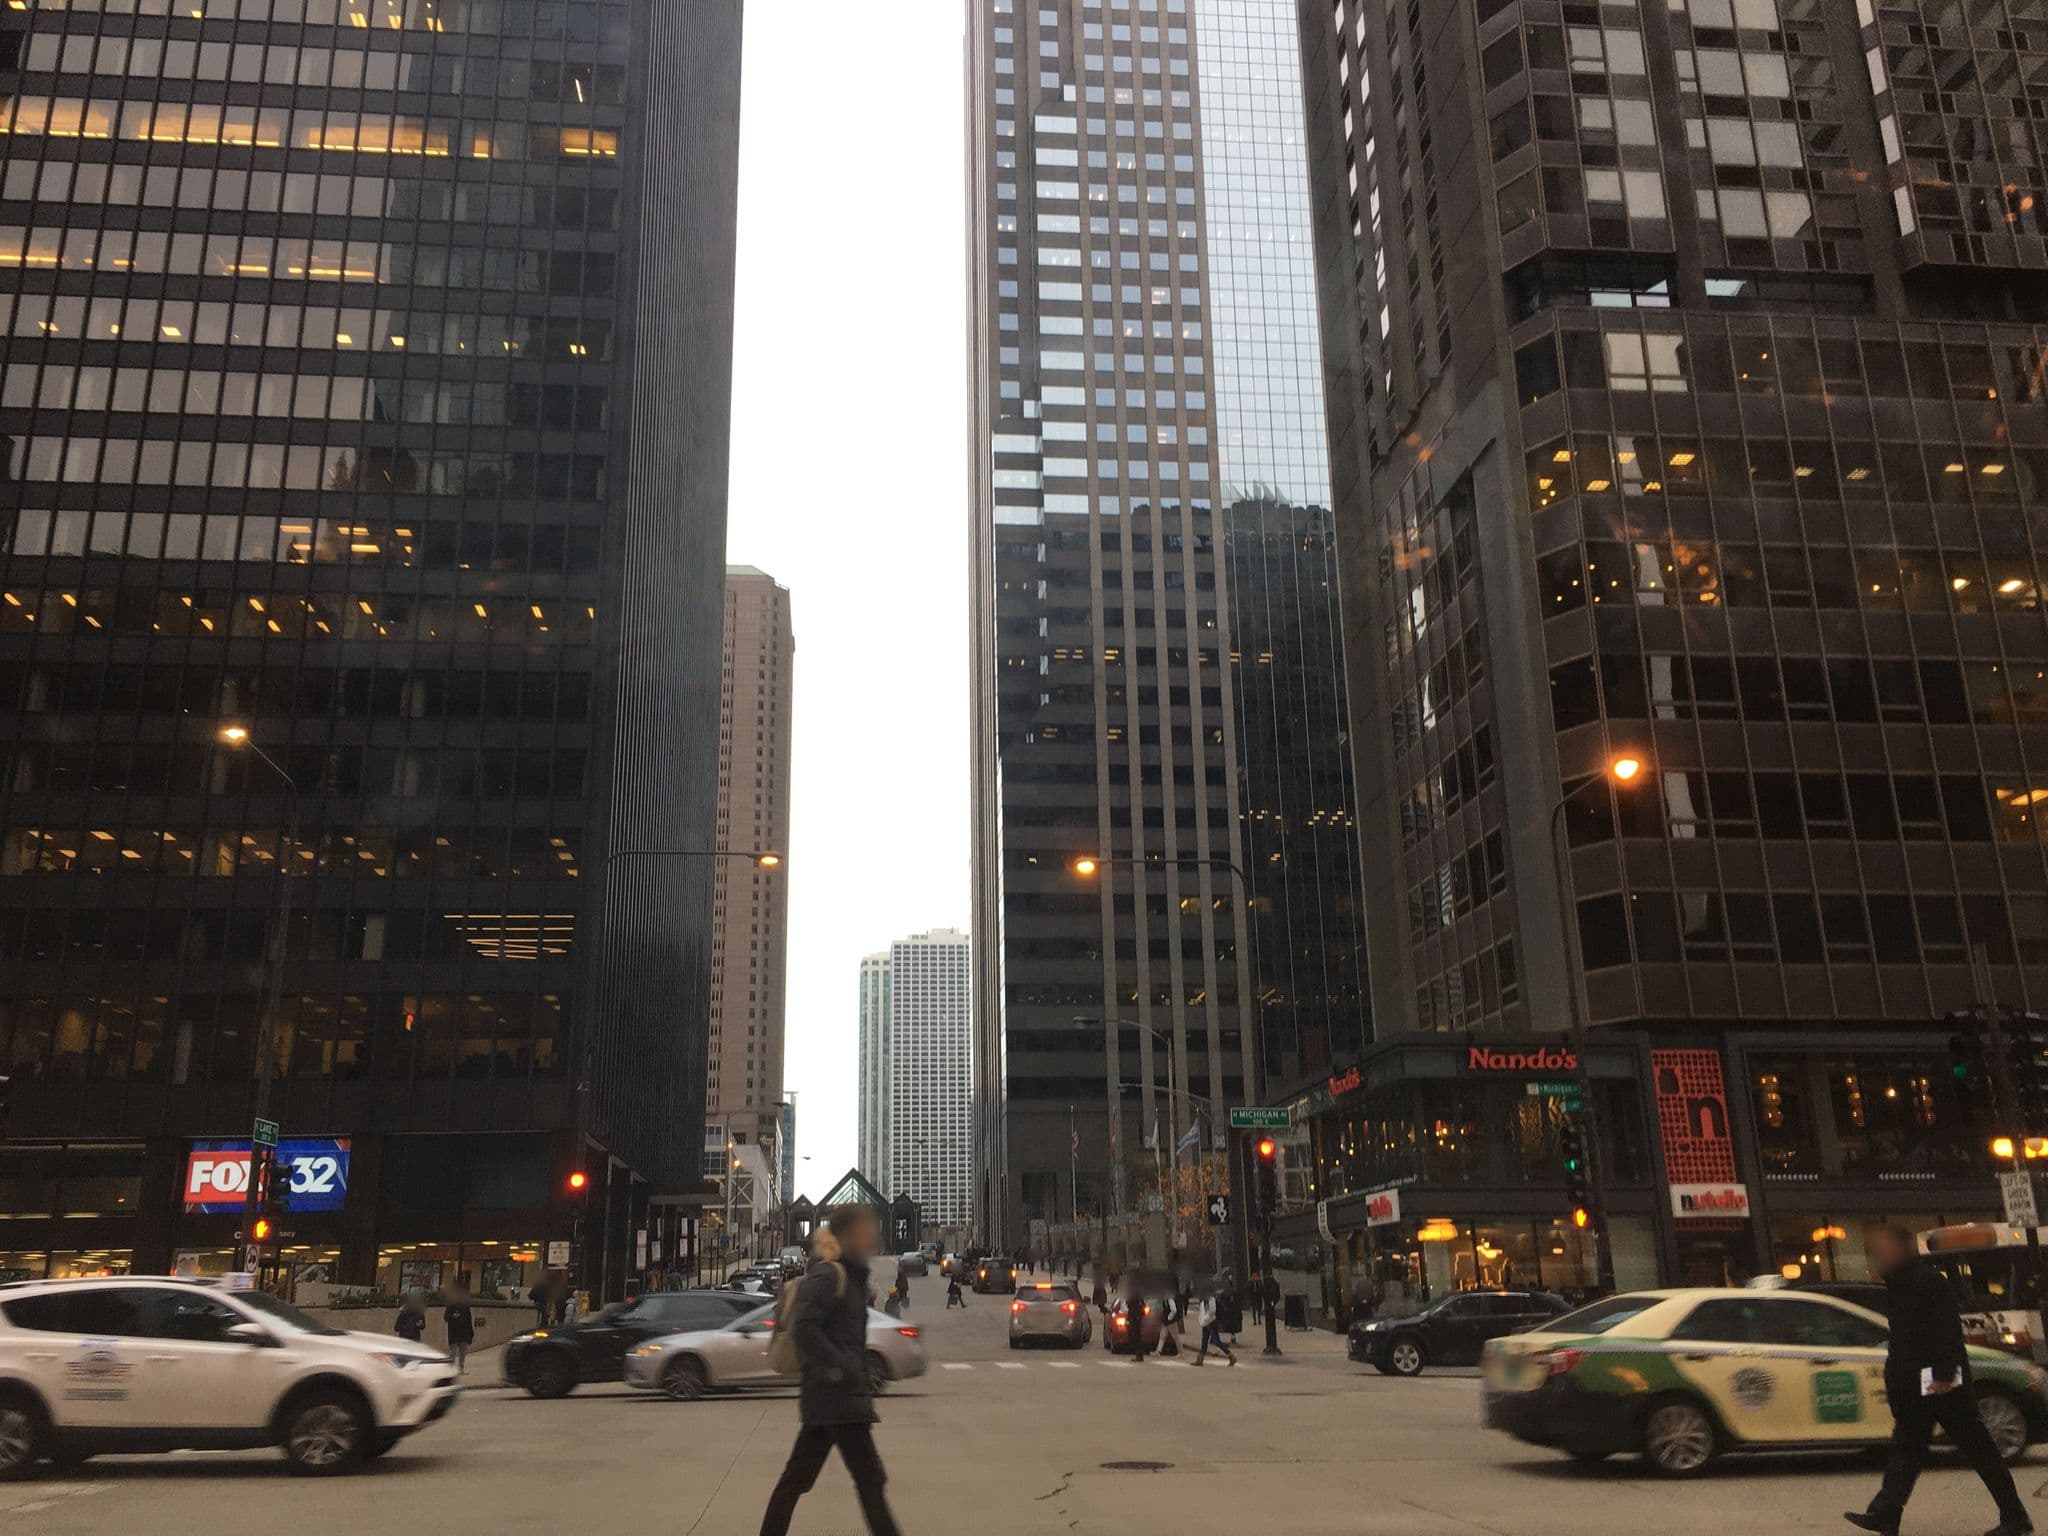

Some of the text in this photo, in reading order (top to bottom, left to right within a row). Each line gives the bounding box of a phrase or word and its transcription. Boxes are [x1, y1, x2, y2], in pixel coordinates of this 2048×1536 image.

[1468, 1046, 1578, 1070] Nando's
[1239, 1110, 1279, 1119] MICHIGAN
[289, 1156, 338, 1193] 32
[1681, 1189, 1747, 1211] nutella
